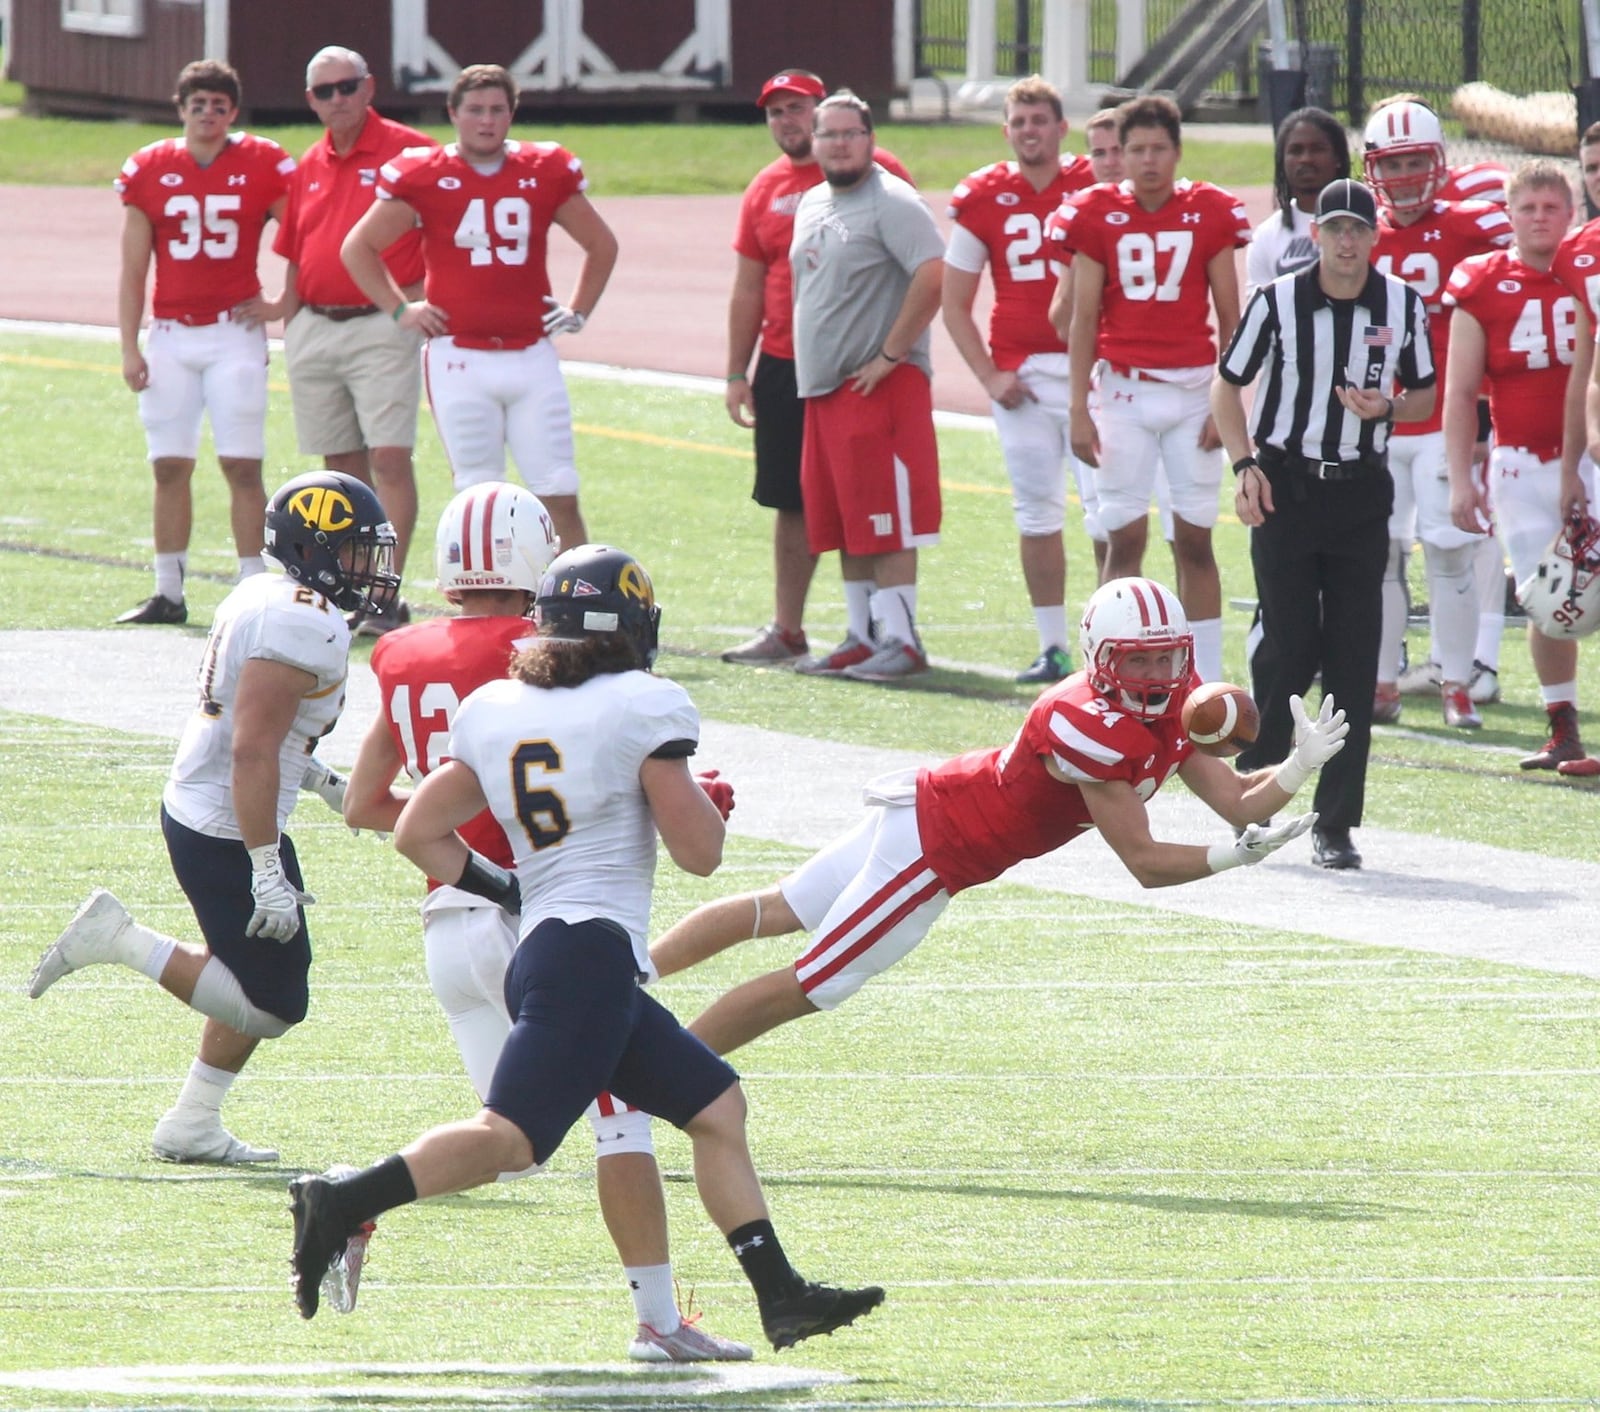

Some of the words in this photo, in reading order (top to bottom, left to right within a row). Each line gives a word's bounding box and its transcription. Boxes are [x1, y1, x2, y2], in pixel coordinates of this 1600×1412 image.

[164, 194, 241, 260] 35
[454, 197, 531, 265] 49
[1117, 230, 1193, 300] 87
[1367, 363, 1383, 381] S
[453, 577, 504, 585] TIGERS
[561, 579, 570, 592] 6
[1081, 697, 1126, 729] 24
[509, 738, 572, 852] 6
